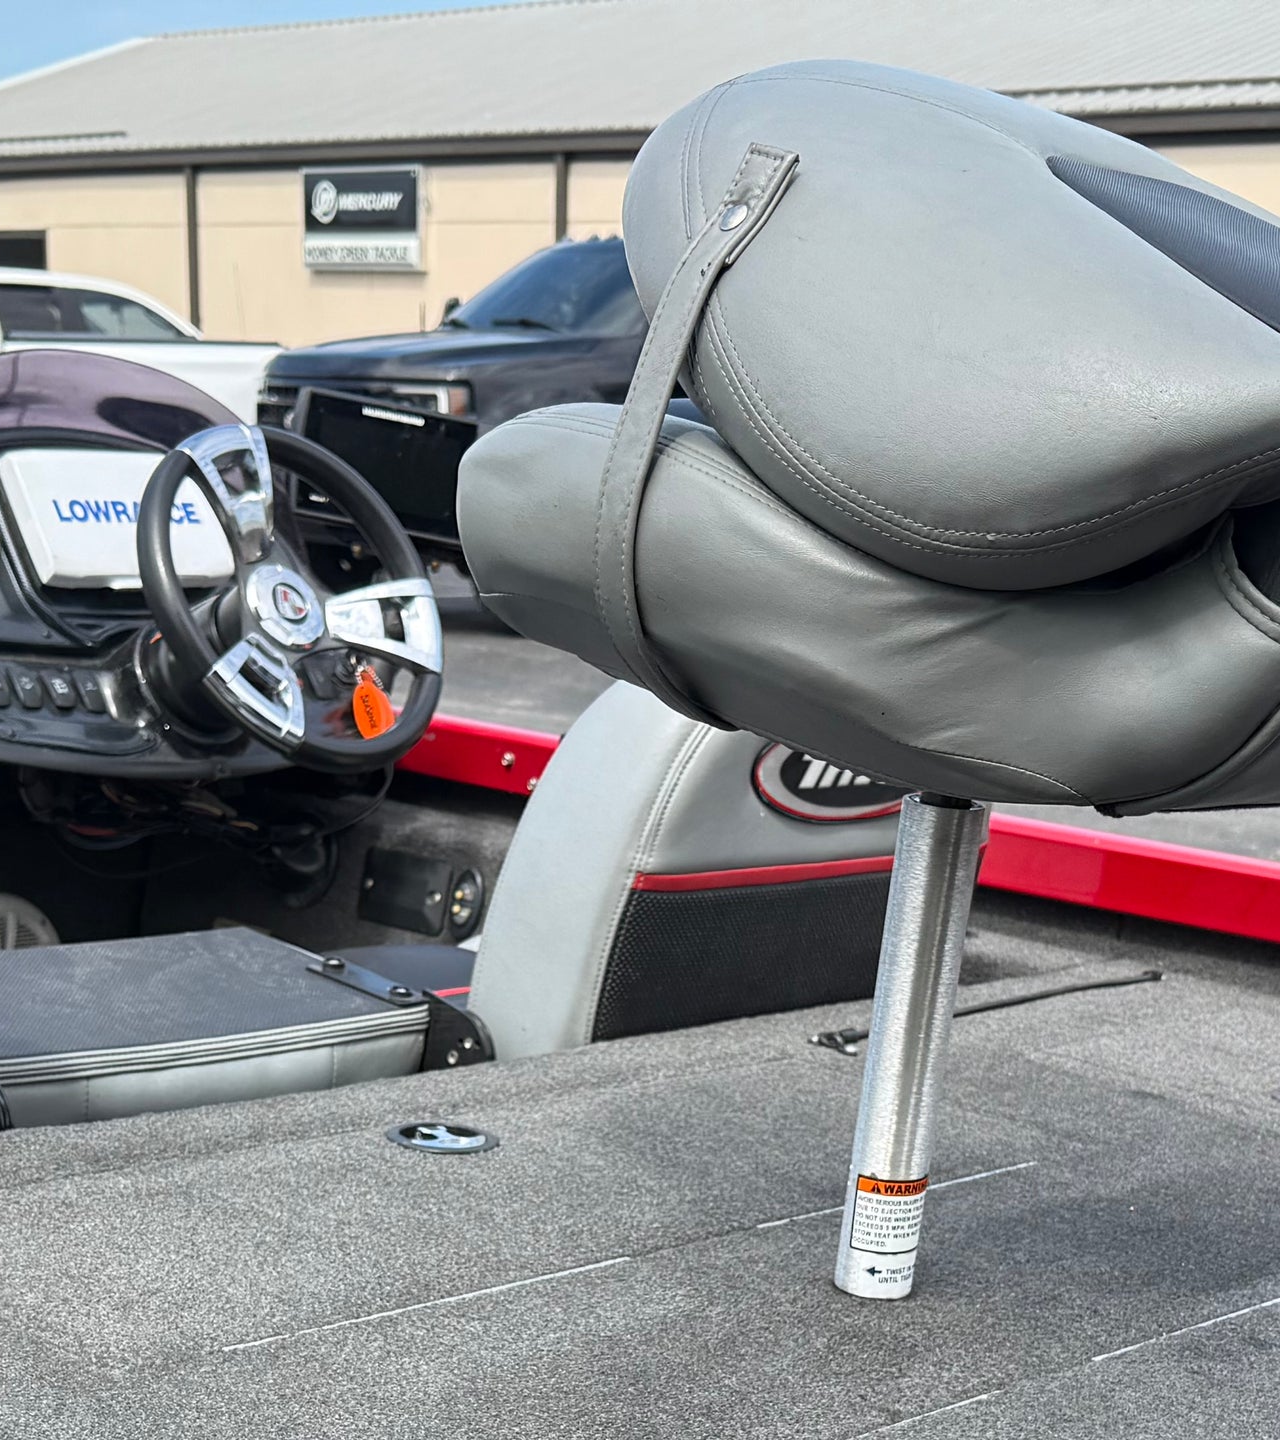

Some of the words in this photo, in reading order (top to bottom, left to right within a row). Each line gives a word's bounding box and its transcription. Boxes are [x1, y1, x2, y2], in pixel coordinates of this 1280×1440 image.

[338, 192, 404, 211] MERCURY
[52, 499, 201, 525] LOWRCE
[876, 1198, 901, 1206] SERIOUS
[886, 1267, 906, 1275] TWIST
[878, 1276, 898, 1284] UNTIL
